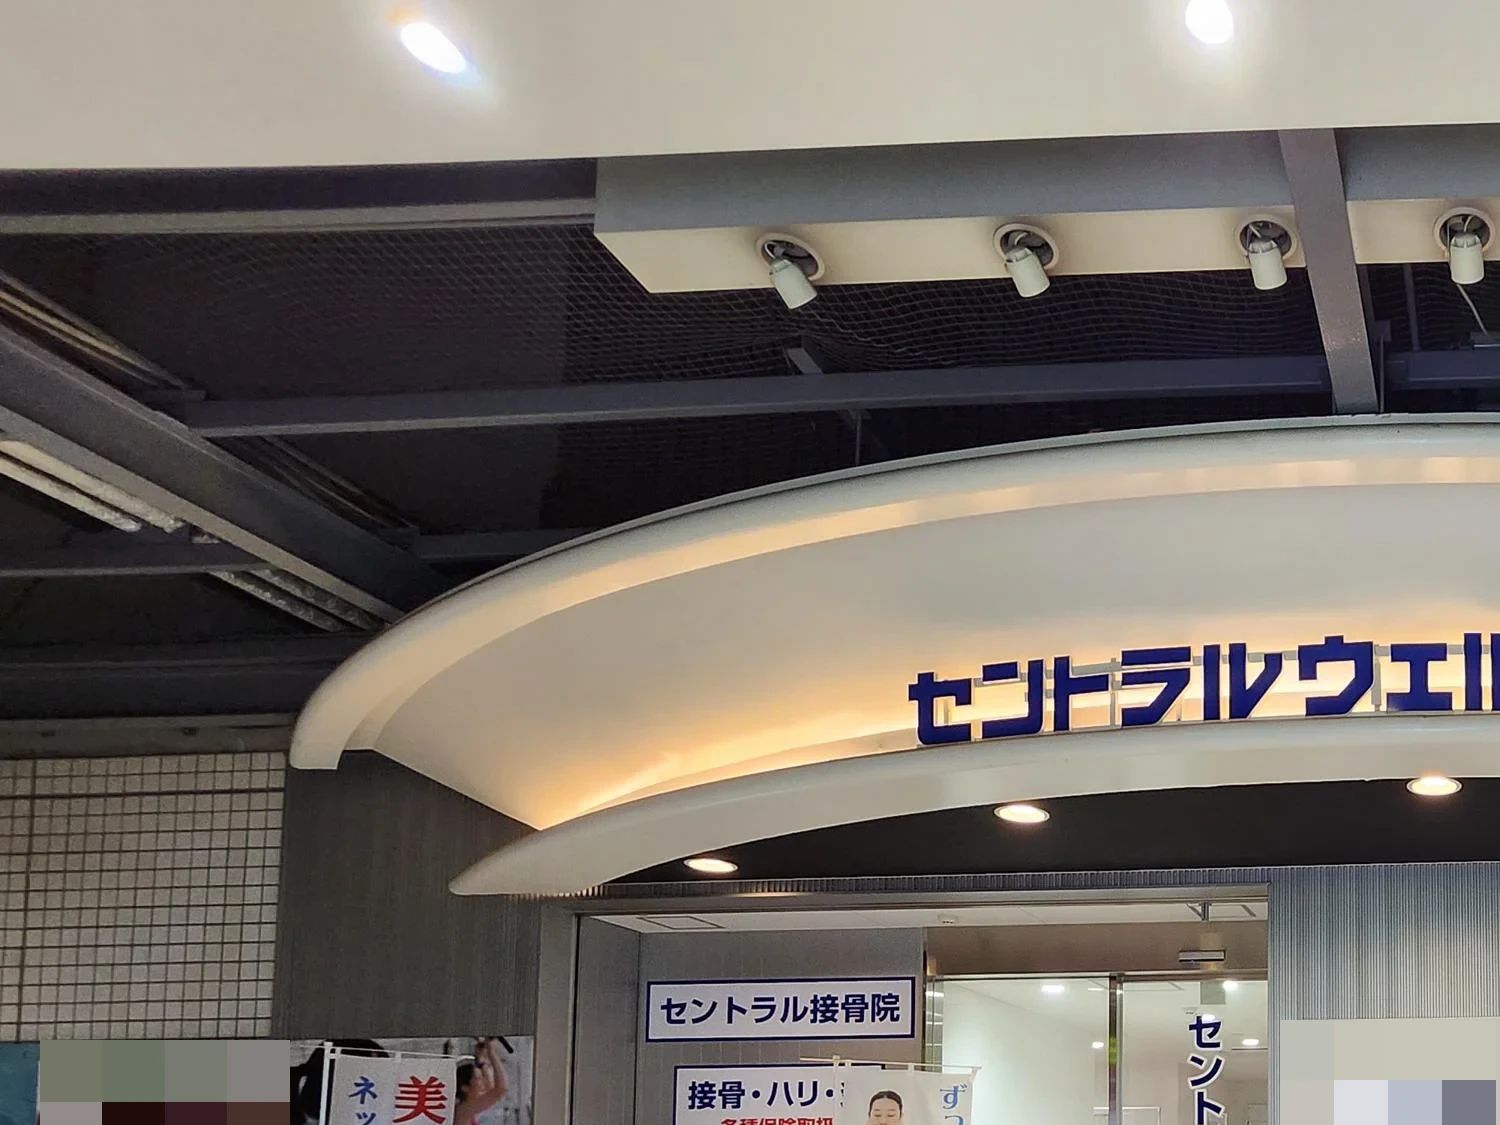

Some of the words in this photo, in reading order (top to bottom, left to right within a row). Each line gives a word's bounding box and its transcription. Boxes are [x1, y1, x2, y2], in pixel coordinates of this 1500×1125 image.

[660, 993, 901, 1025] セントラル接骨院
[688, 1081, 845, 1110] 接骨・ハリ・
